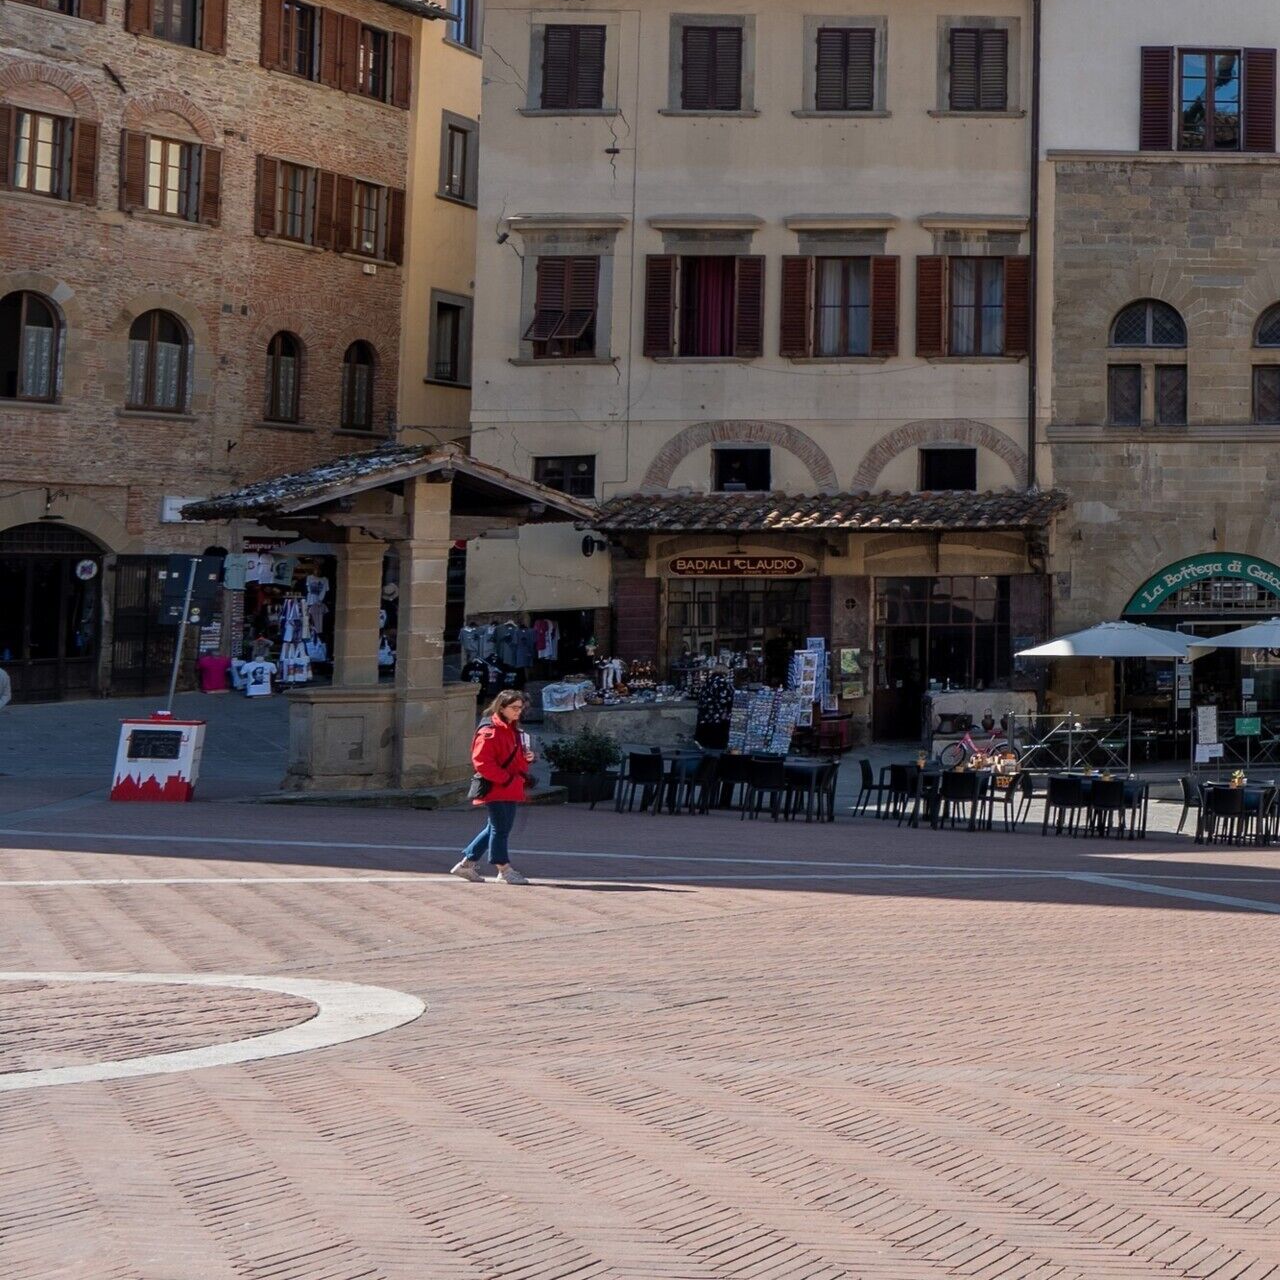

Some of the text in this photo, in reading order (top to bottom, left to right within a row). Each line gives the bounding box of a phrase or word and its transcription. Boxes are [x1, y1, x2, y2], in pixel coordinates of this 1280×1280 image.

[676, 559, 797, 570] BADIALI CLAUDIO
[1142, 585, 1164, 603] La
[1163, 562, 1223, 587] Bottega
[1227, 560, 1242, 573] di
